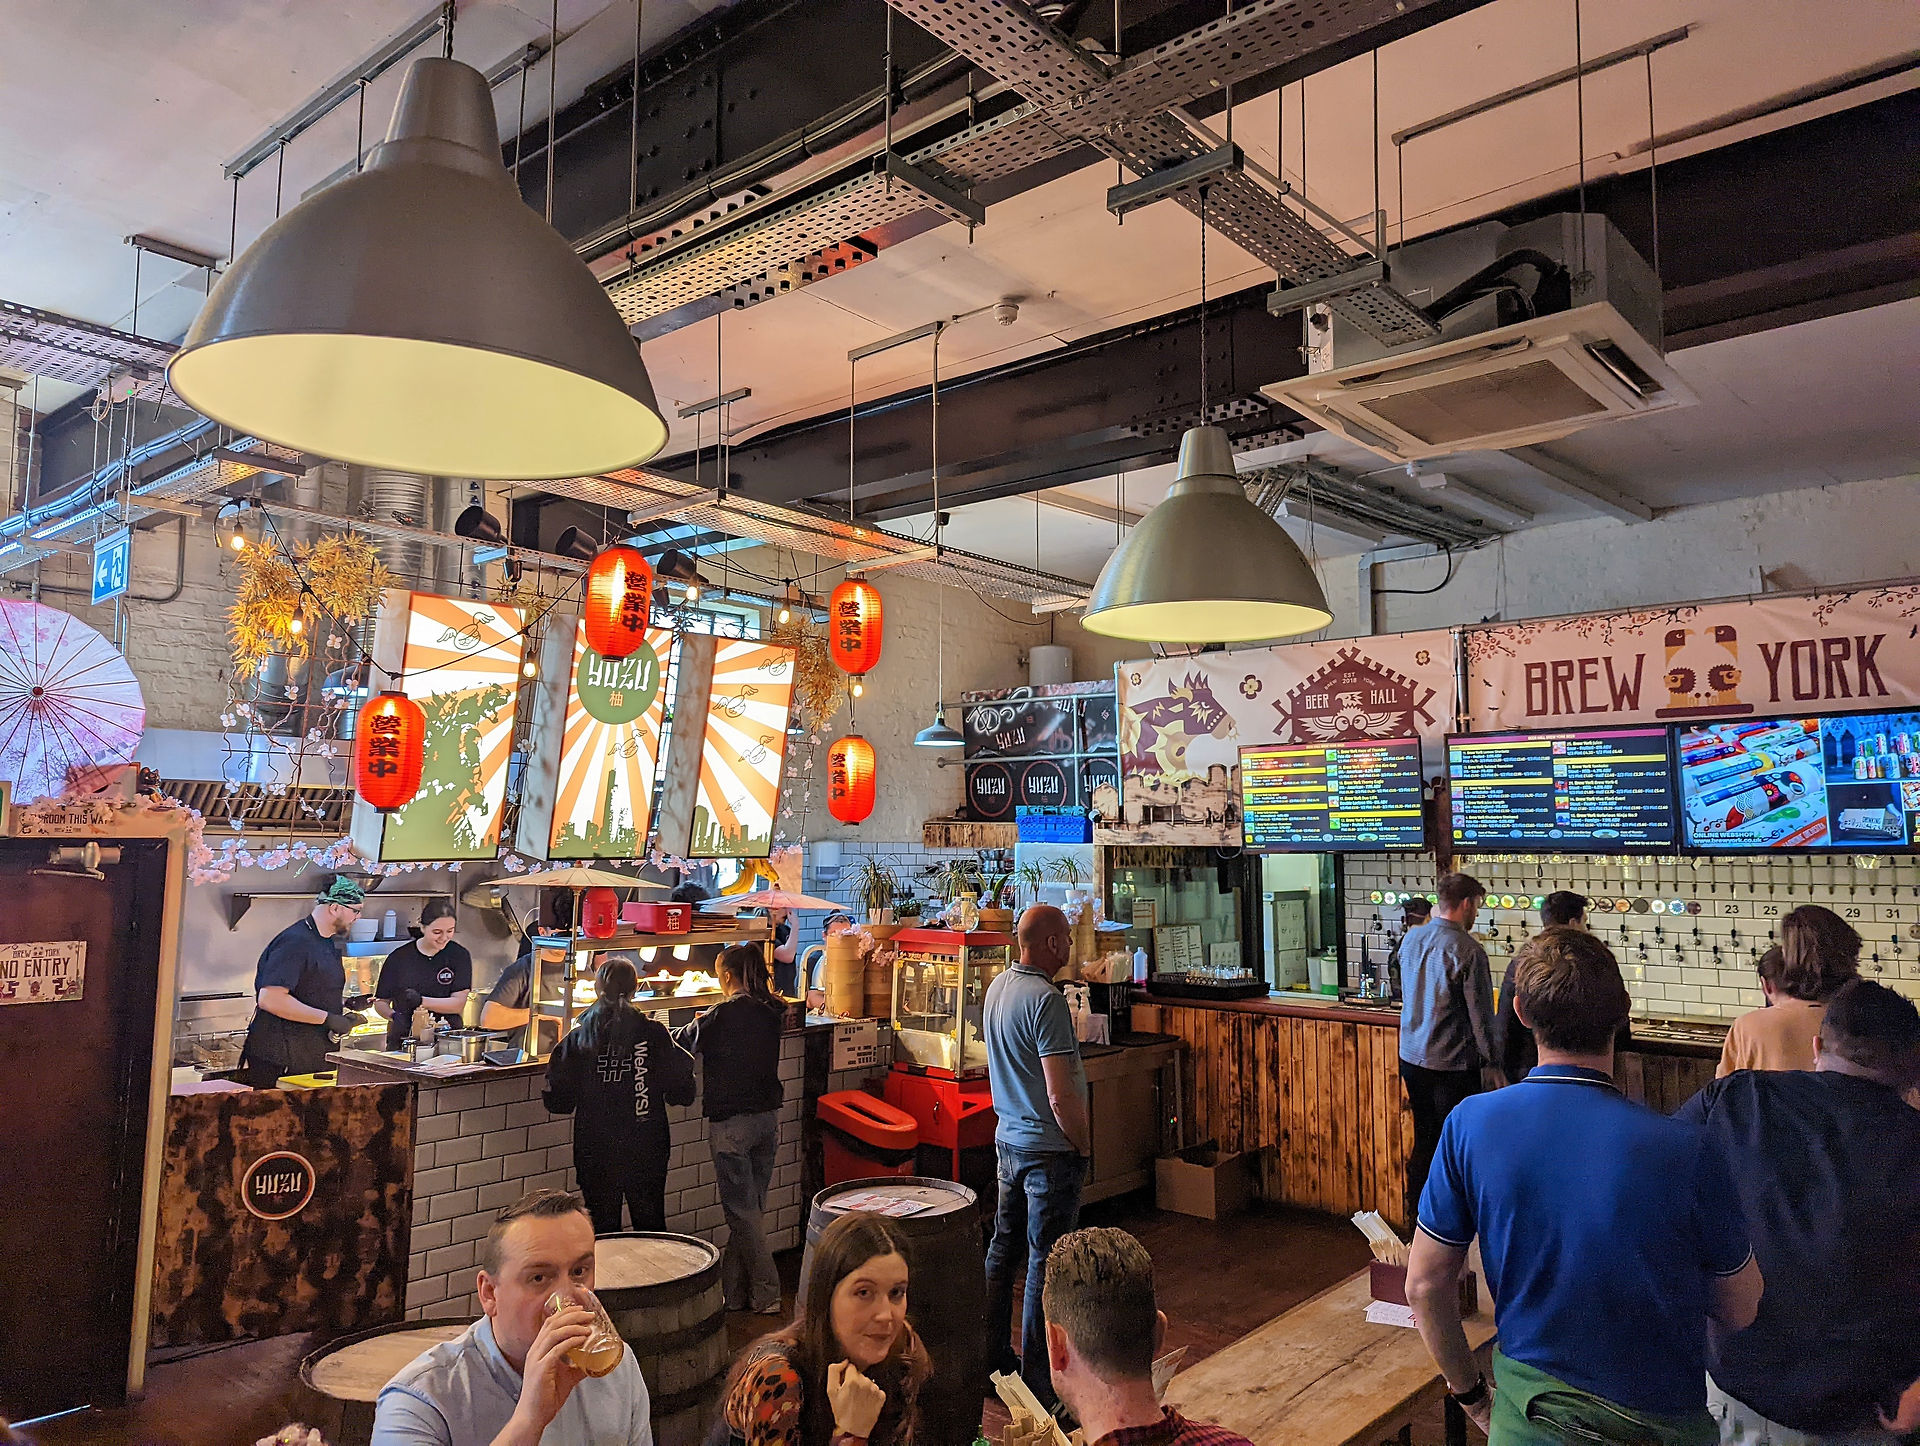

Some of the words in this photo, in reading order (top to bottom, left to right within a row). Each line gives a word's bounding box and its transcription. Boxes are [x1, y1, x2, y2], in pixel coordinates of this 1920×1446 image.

[1523, 654, 1647, 717] BREW
[1757, 634, 1890, 702] YORK
[1324, 678, 1337, 690] BREW
[1363, 677, 1375, 686] YORK
[1305, 694, 1329, 710] BEER
[1370, 689, 1398, 705] HALL
[69, 814, 88, 824] THIS
[1725, 905, 1739, 914] 23
[1763, 906, 1778, 915] 25
[1846, 909, 1860, 918] 29
[1886, 909, 1900, 918] 31
[12, 950, 32, 958] BREW
[0, 960, 18, 978] NO
[24, 957, 70, 977] ENTRY
[255, 1172, 302, 1195] YUZU
